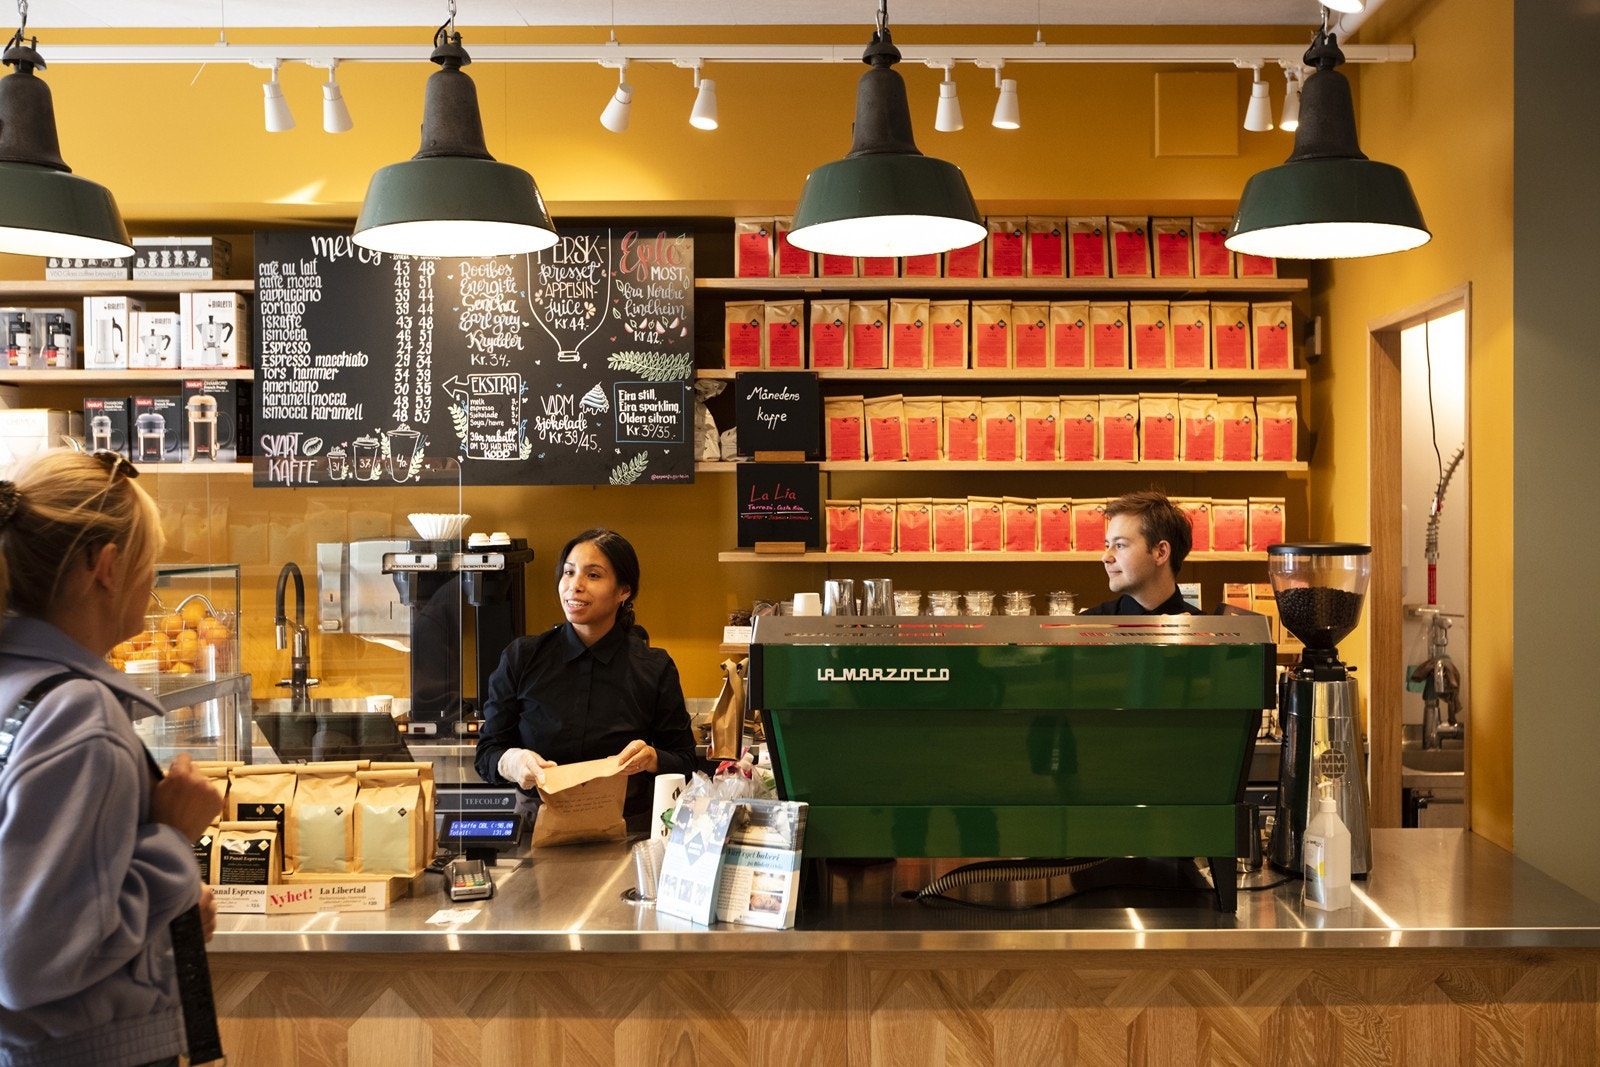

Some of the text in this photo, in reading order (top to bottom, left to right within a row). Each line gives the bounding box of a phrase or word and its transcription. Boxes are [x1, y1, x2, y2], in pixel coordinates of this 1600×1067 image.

[282, 263, 296, 276] au
[300, 258, 318, 276] lait
[394, 260, 411, 276] 43
[418, 260, 436, 276] 48
[459, 260, 514, 279] Rooibos
[538, 262, 601, 285] presset
[651, 266, 686, 280] MOST
[287, 276, 323, 289] mocca
[394, 275, 411, 289] 46
[419, 275, 432, 289] 51
[260, 287, 322, 303] cappuccino
[394, 288, 411, 302] 39
[418, 288, 434, 302] 44
[545, 281, 598, 299] APPELSIN-
[211, 300, 233, 309] BIALETTI
[261, 300, 306, 315] cortado
[395, 302, 411, 316] 39
[417, 302, 434, 316] 44
[461, 292, 519, 314] Sencha
[544, 298, 584, 322] juice
[395, 315, 413, 330] 43
[418, 316, 434, 330] 48
[459, 311, 520, 335] Earl grey
[395, 329, 412, 342] 46
[419, 329, 432, 342] 51
[465, 329, 525, 354] Krydder
[261, 341, 311, 355] Espresso
[396, 341, 413, 355] 24
[416, 341, 432, 355] 29
[261, 350, 369, 368] Espresso macchiato
[394, 354, 411, 368] 29
[416, 354, 432, 369] 34
[261, 367, 339, 381] Tors hammer
[394, 368, 410, 383] 34
[415, 368, 431, 382] 39
[262, 379, 319, 394] Americano
[394, 383, 410, 396] 30
[415, 382, 431, 396] 35
[471, 375, 517, 396] EKSTRA
[618, 389, 636, 402] Eira
[746, 386, 800, 401] Månedens
[393, 395, 410, 410] 48
[415, 395, 432, 410] 53
[540, 394, 574, 416] VARM
[618, 401, 637, 412] Eira
[311, 403, 363, 421] karamell
[392, 408, 408, 422] 48
[414, 408, 431, 424] 53
[618, 412, 646, 424] Olden
[756, 406, 788, 430] kaffe
[534, 411, 588, 440] sjokolade
[260, 432, 304, 461] SVART
[269, 459, 319, 487] KAFFE
[750, 483, 797, 503] La Lia
[231, 888, 265, 897] Espresso
[269, 887, 313, 908] Nyhet!
[319, 885, 367, 895] La Libertad
